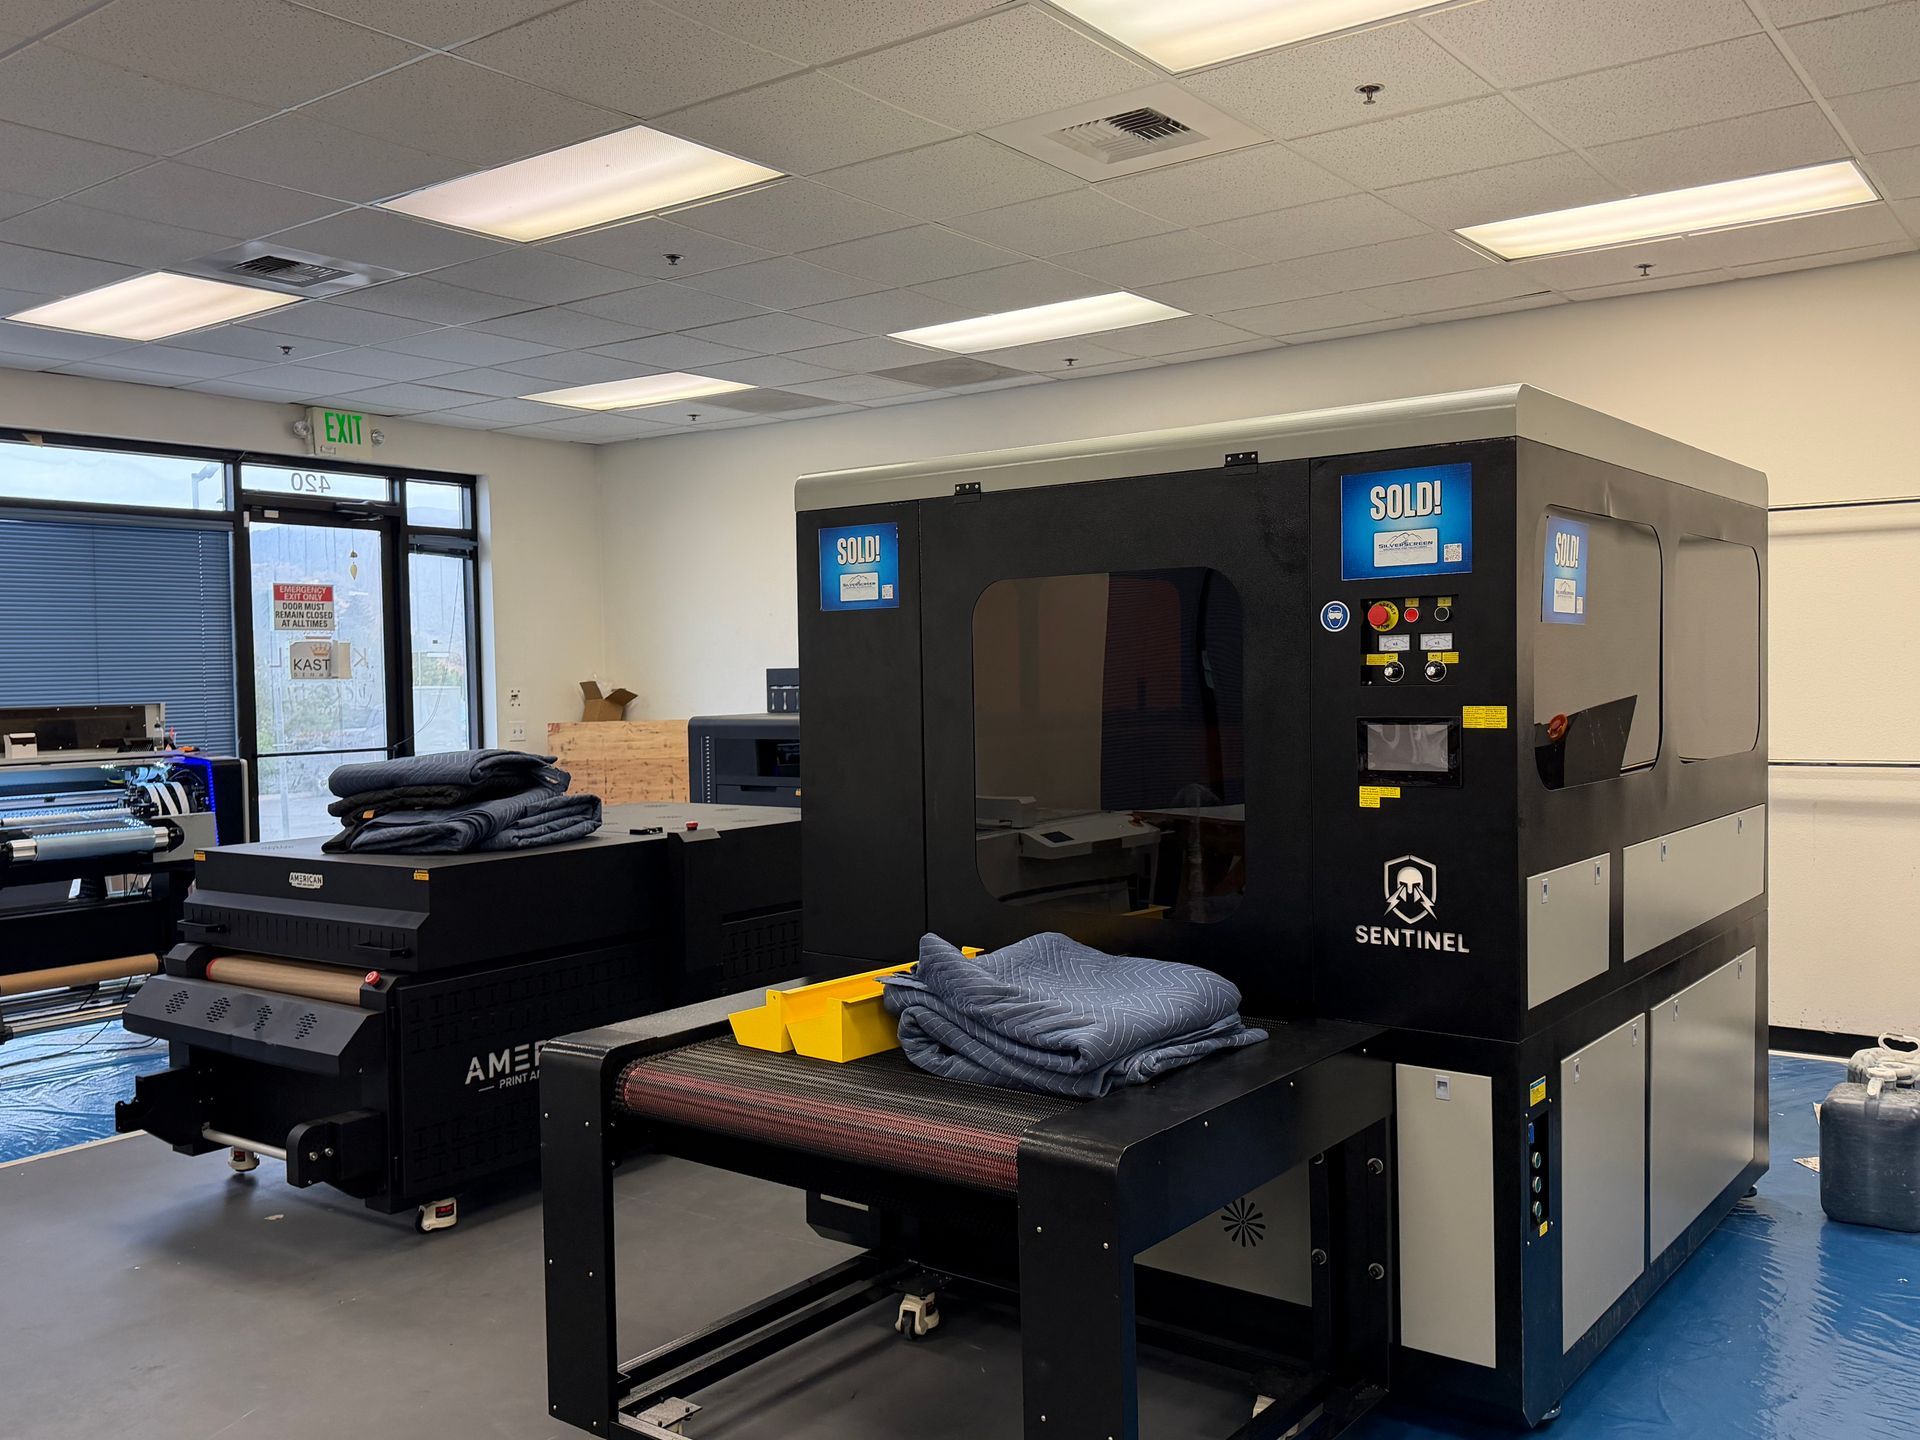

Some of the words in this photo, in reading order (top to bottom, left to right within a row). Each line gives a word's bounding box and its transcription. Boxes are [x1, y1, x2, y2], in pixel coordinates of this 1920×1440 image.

[324, 412, 362, 445] EXIT
[1370, 480, 1442, 520] SOLD!
[837, 535, 880, 565] SOLD!
[1554, 532, 1580, 568] SOLD!
[280, 585, 327, 594] EMERGENCY
[302, 593, 323, 601] ONLY
[282, 602, 303, 611] DOOR
[304, 602, 325, 611] MUST
[275, 611, 304, 619] REMAIN
[305, 611, 333, 620] CLOSED
[281, 619, 291, 627] AT
[292, 619, 305, 628] ALL
[305, 620, 328, 628] TIMES
[289, 873, 323, 884] AMERICAN
[1355, 924, 1470, 953] SENTINEL
[499, 1072, 528, 1089] PRINT
